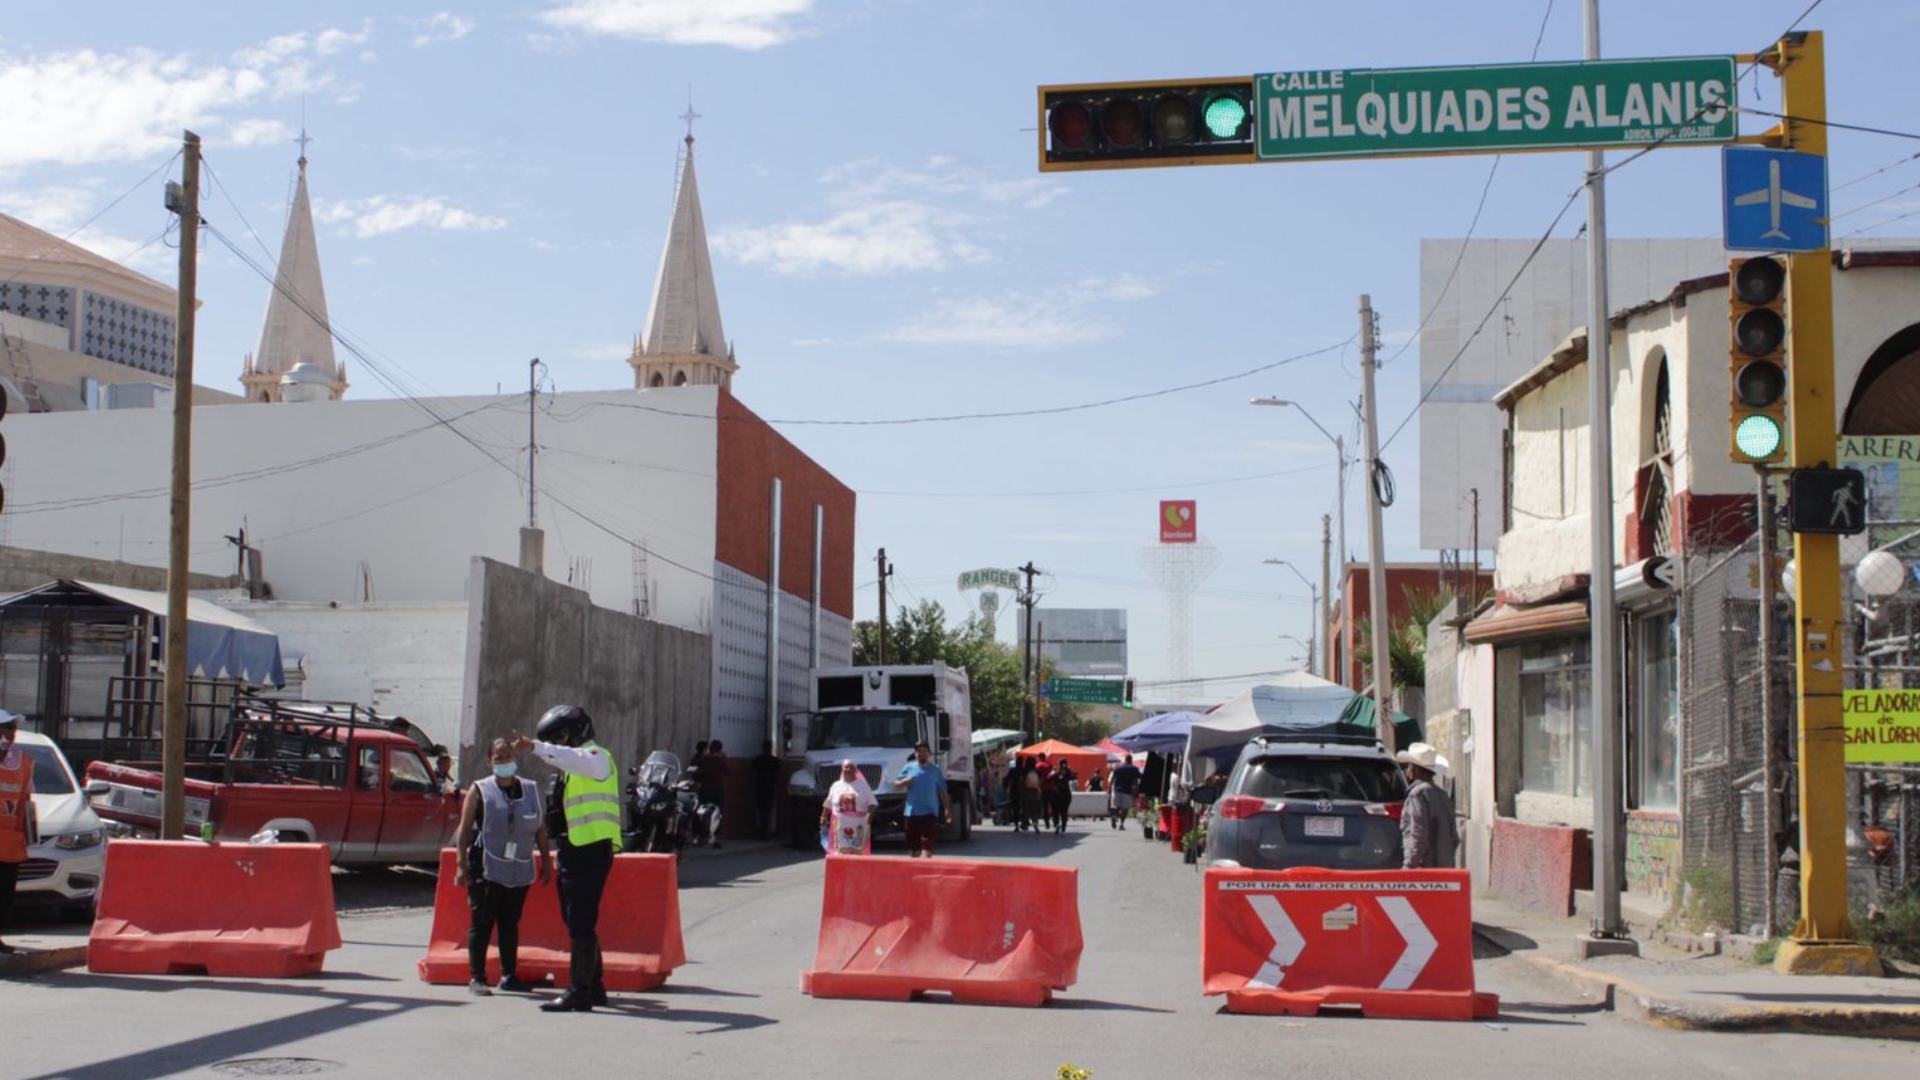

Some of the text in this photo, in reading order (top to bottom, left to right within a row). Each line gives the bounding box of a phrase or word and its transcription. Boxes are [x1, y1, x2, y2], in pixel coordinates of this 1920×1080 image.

[1271, 71, 1344, 91] CALLE
[1268, 79, 1726, 140] MELQUIADES ALANIS
[1838, 436, 1920, 463] ARER
[962, 570, 1017, 587] RANGER
[1877, 714, 1894, 725] de
[1843, 726, 1876, 744] SAN
